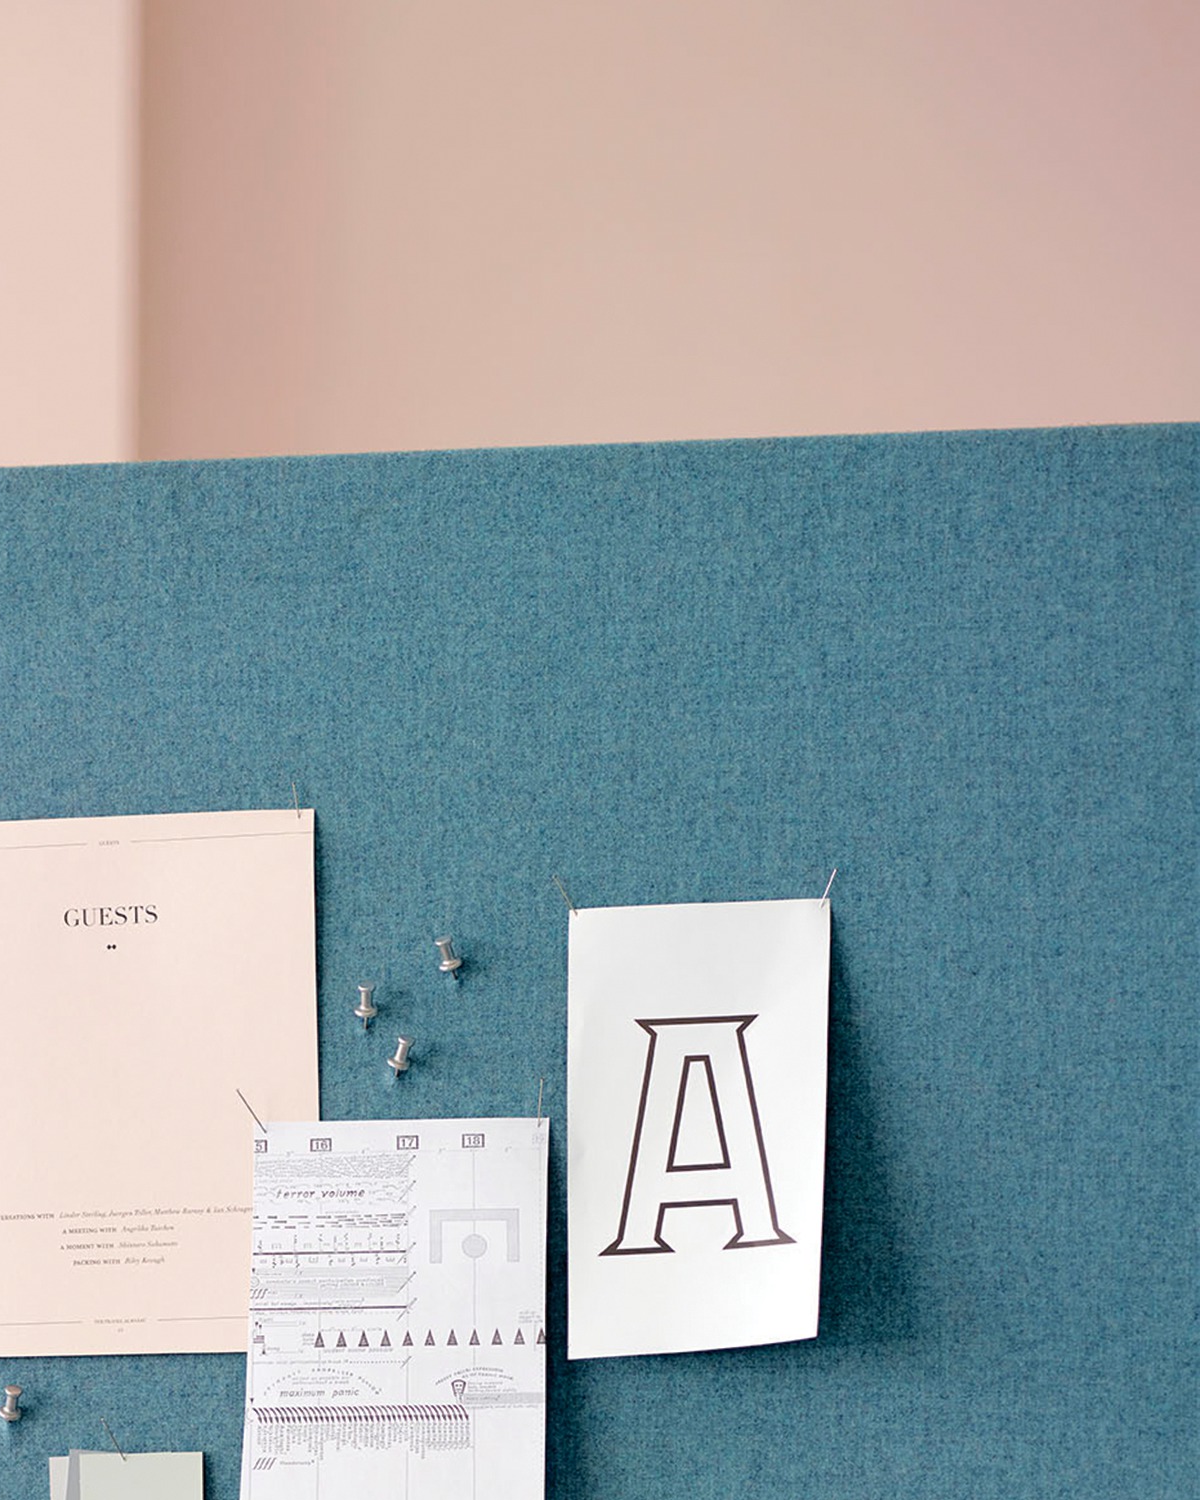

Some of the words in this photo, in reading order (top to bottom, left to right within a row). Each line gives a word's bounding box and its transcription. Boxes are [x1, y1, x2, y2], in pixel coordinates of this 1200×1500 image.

[63, 904, 158, 927] GUESTS
[467, 1136, 481, 1146] 18
[598, 1014, 797, 1257] A
[315, 1141, 329, 1150] 16
[401, 1138, 414, 1147] 17
[276, 1188, 315, 1199] terror
[321, 1188, 365, 1198] volume
[280, 1387, 326, 1398] maximum
[331, 1387, 360, 1399] panic
